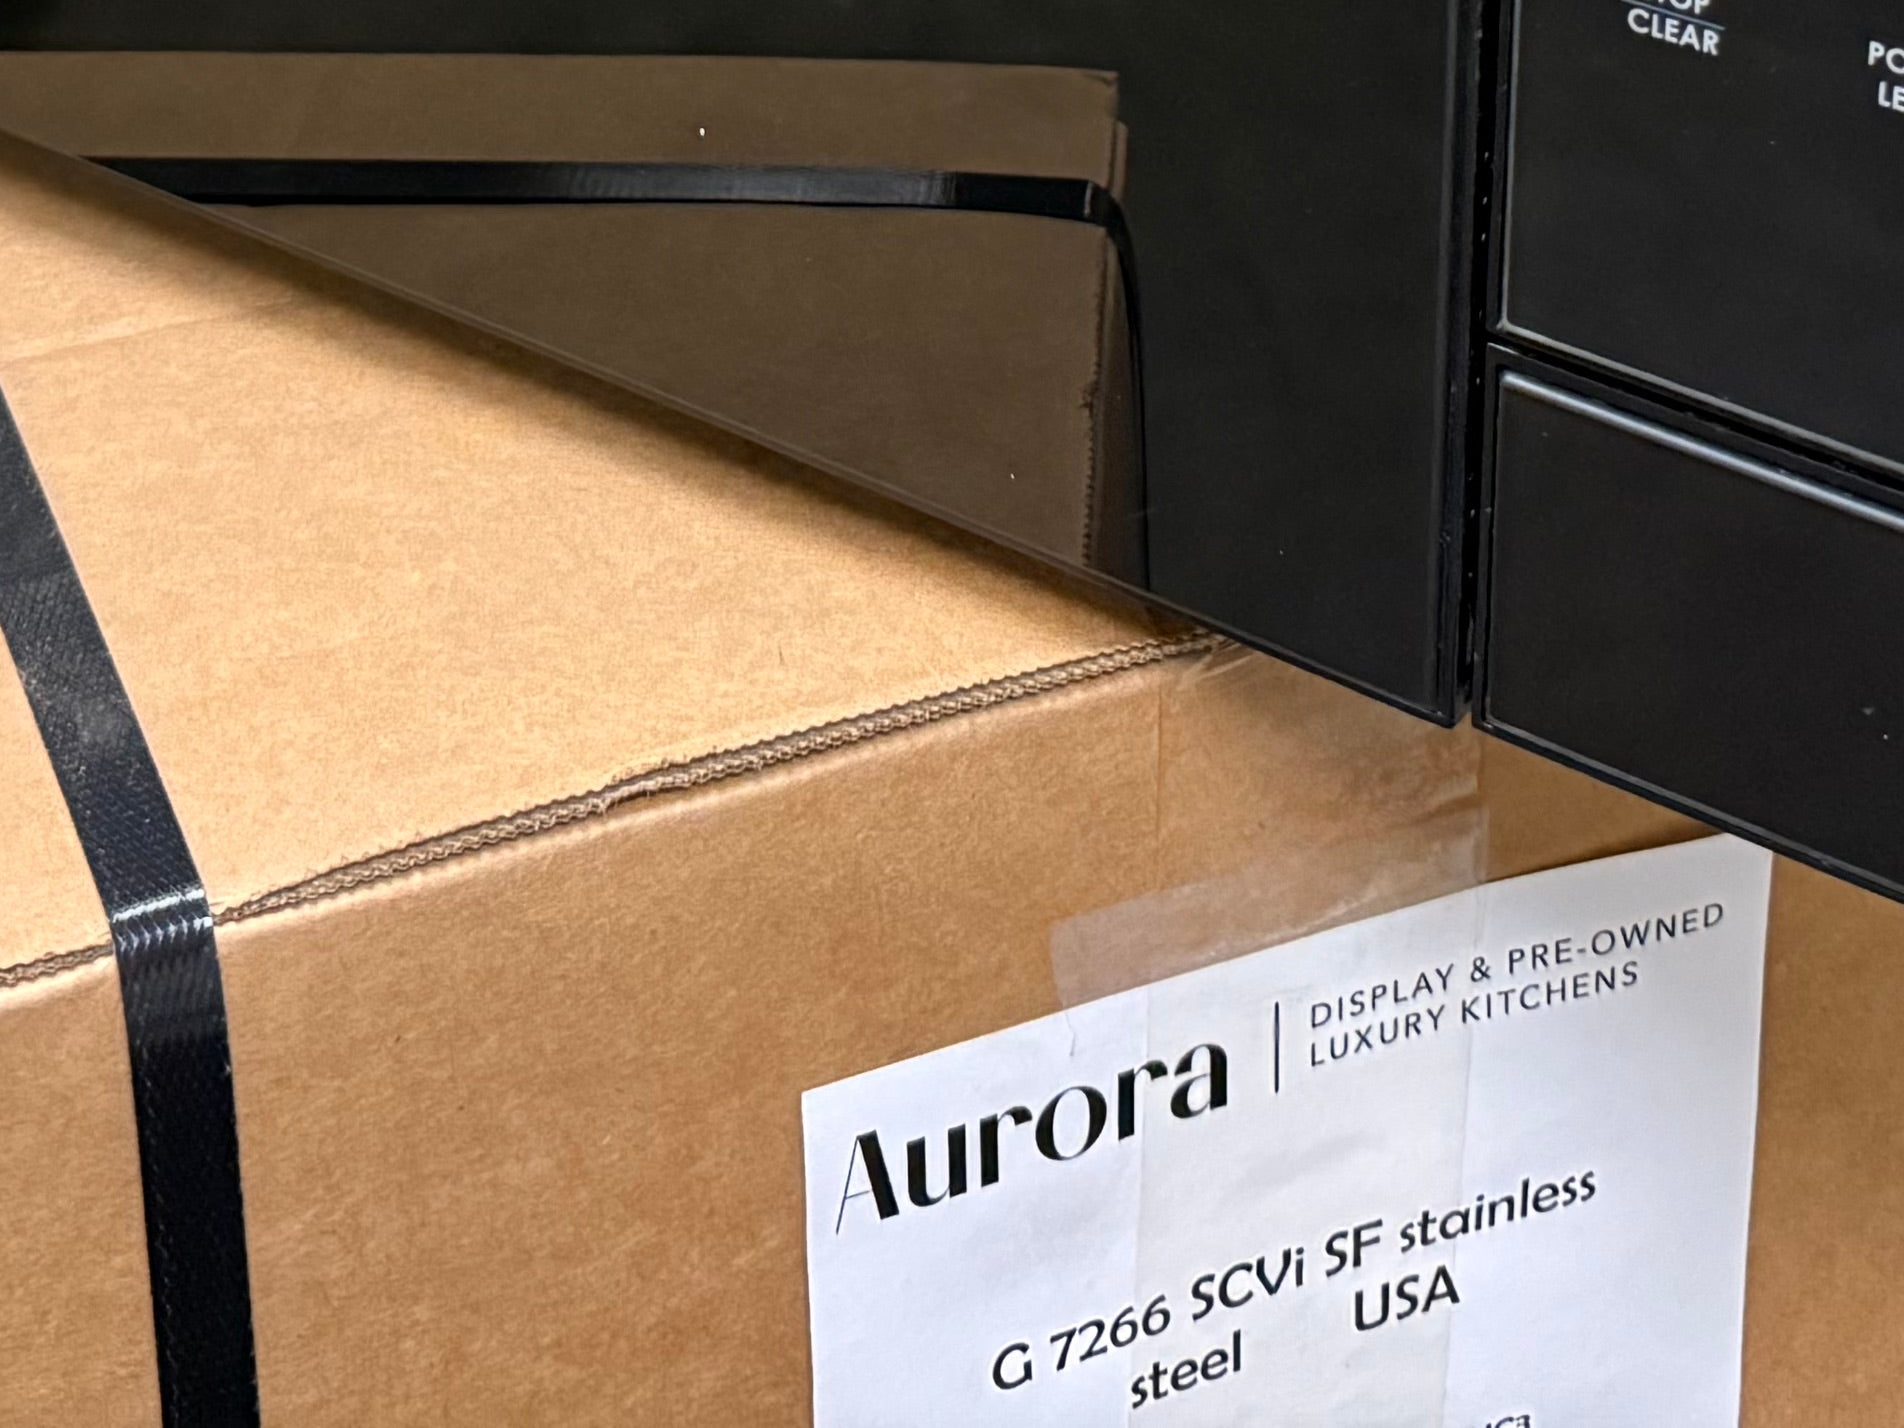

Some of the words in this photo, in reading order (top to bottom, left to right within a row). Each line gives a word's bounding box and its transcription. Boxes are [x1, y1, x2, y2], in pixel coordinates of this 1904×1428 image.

[1626, 7, 1721, 56] CLEAR
[1311, 963, 1454, 1029] DISPLAY
[1470, 955, 1491, 982] &
[1508, 902, 1725, 974] PRE-OWNED
[1311, 1004, 1446, 1067] LUXURY
[1461, 961, 1639, 1024] KITCHENS
[836, 1043, 1229, 1235] Aurora
[992, 1343, 1033, 1391] G
[1049, 1294, 1172, 1371] 7266
[1191, 1246, 1305, 1322] SCVi
[1324, 1220, 1384, 1280] SF
[1398, 1169, 1597, 1255] stainless
[1131, 1330, 1243, 1409] steel
[1353, 1264, 1460, 1332] USA
